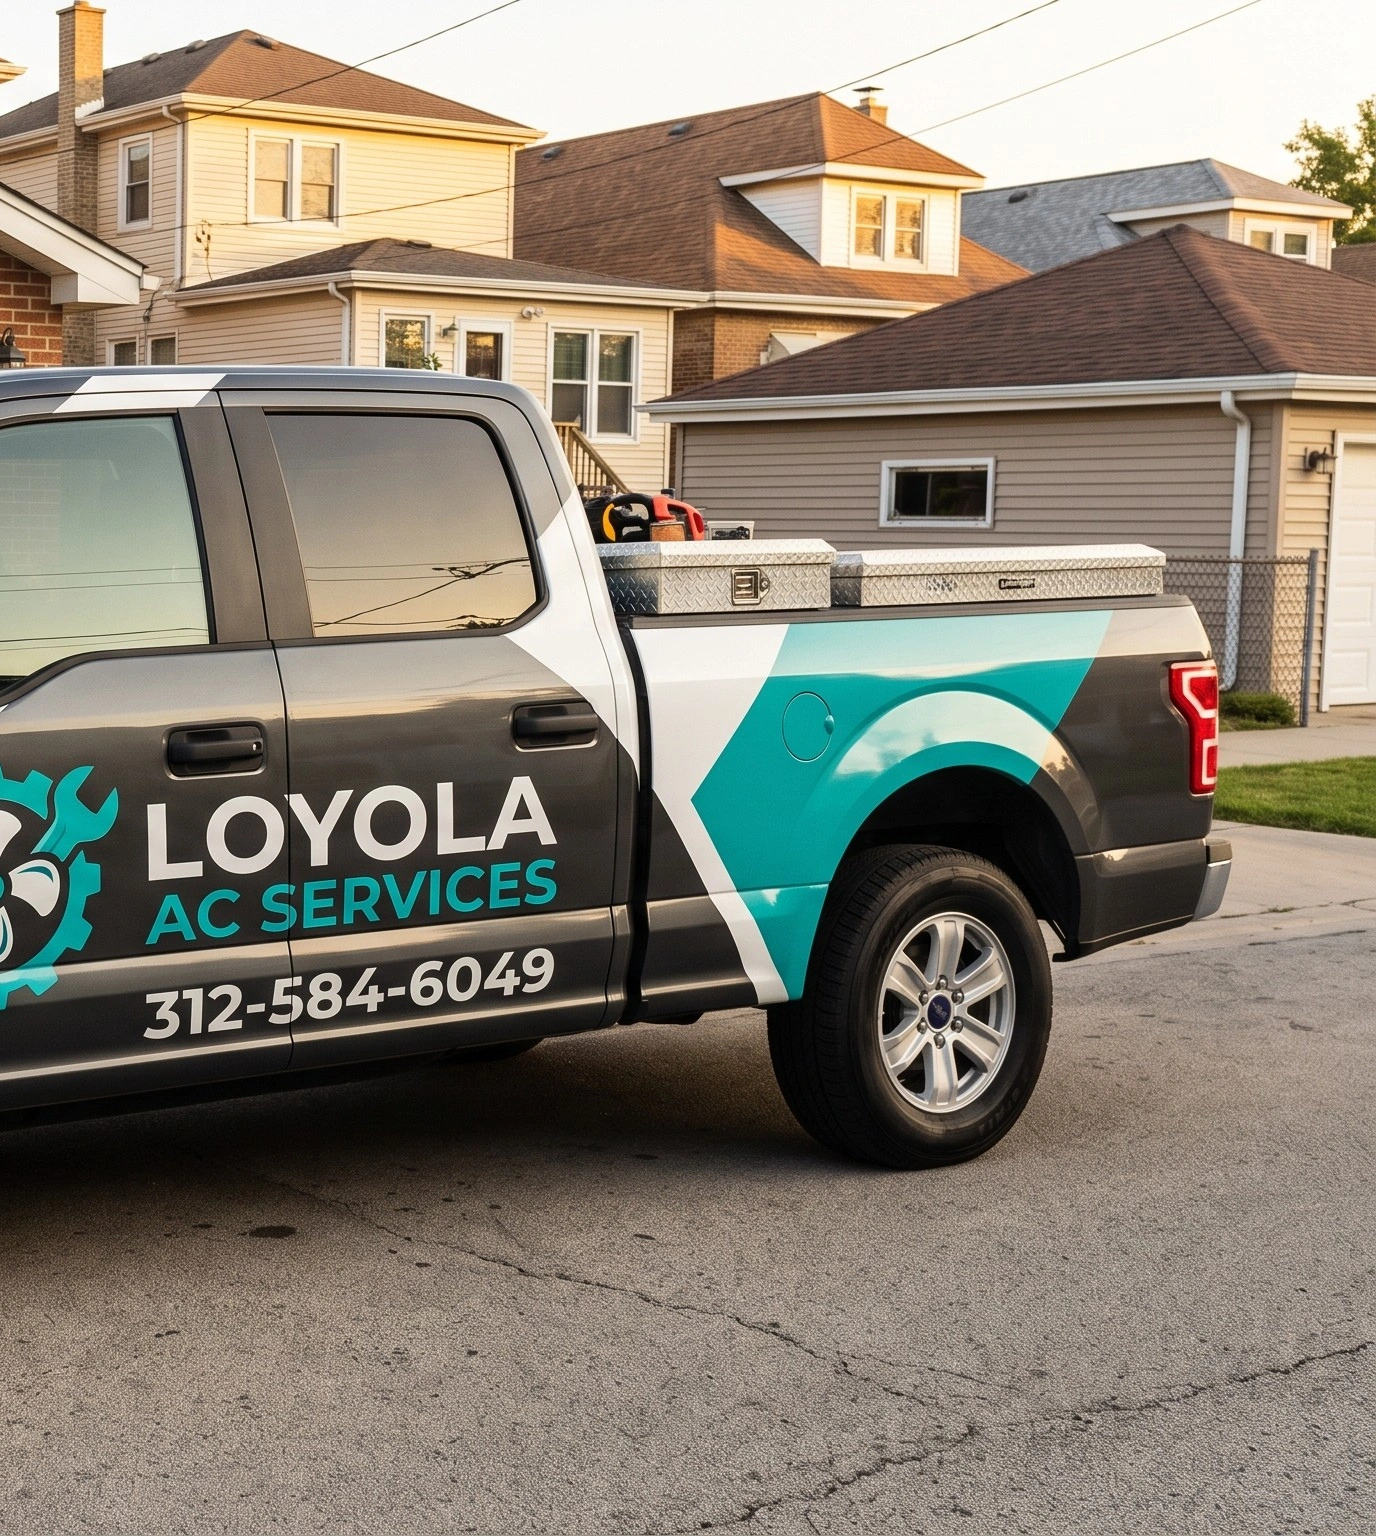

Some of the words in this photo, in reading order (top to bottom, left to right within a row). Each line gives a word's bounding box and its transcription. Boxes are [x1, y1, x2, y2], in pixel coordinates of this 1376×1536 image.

[146, 775, 558, 882] LOYOLA
[145, 888, 241, 945] AC
[260, 858, 558, 933] SERVICES
[143, 947, 555, 1041] 312-584-6049
